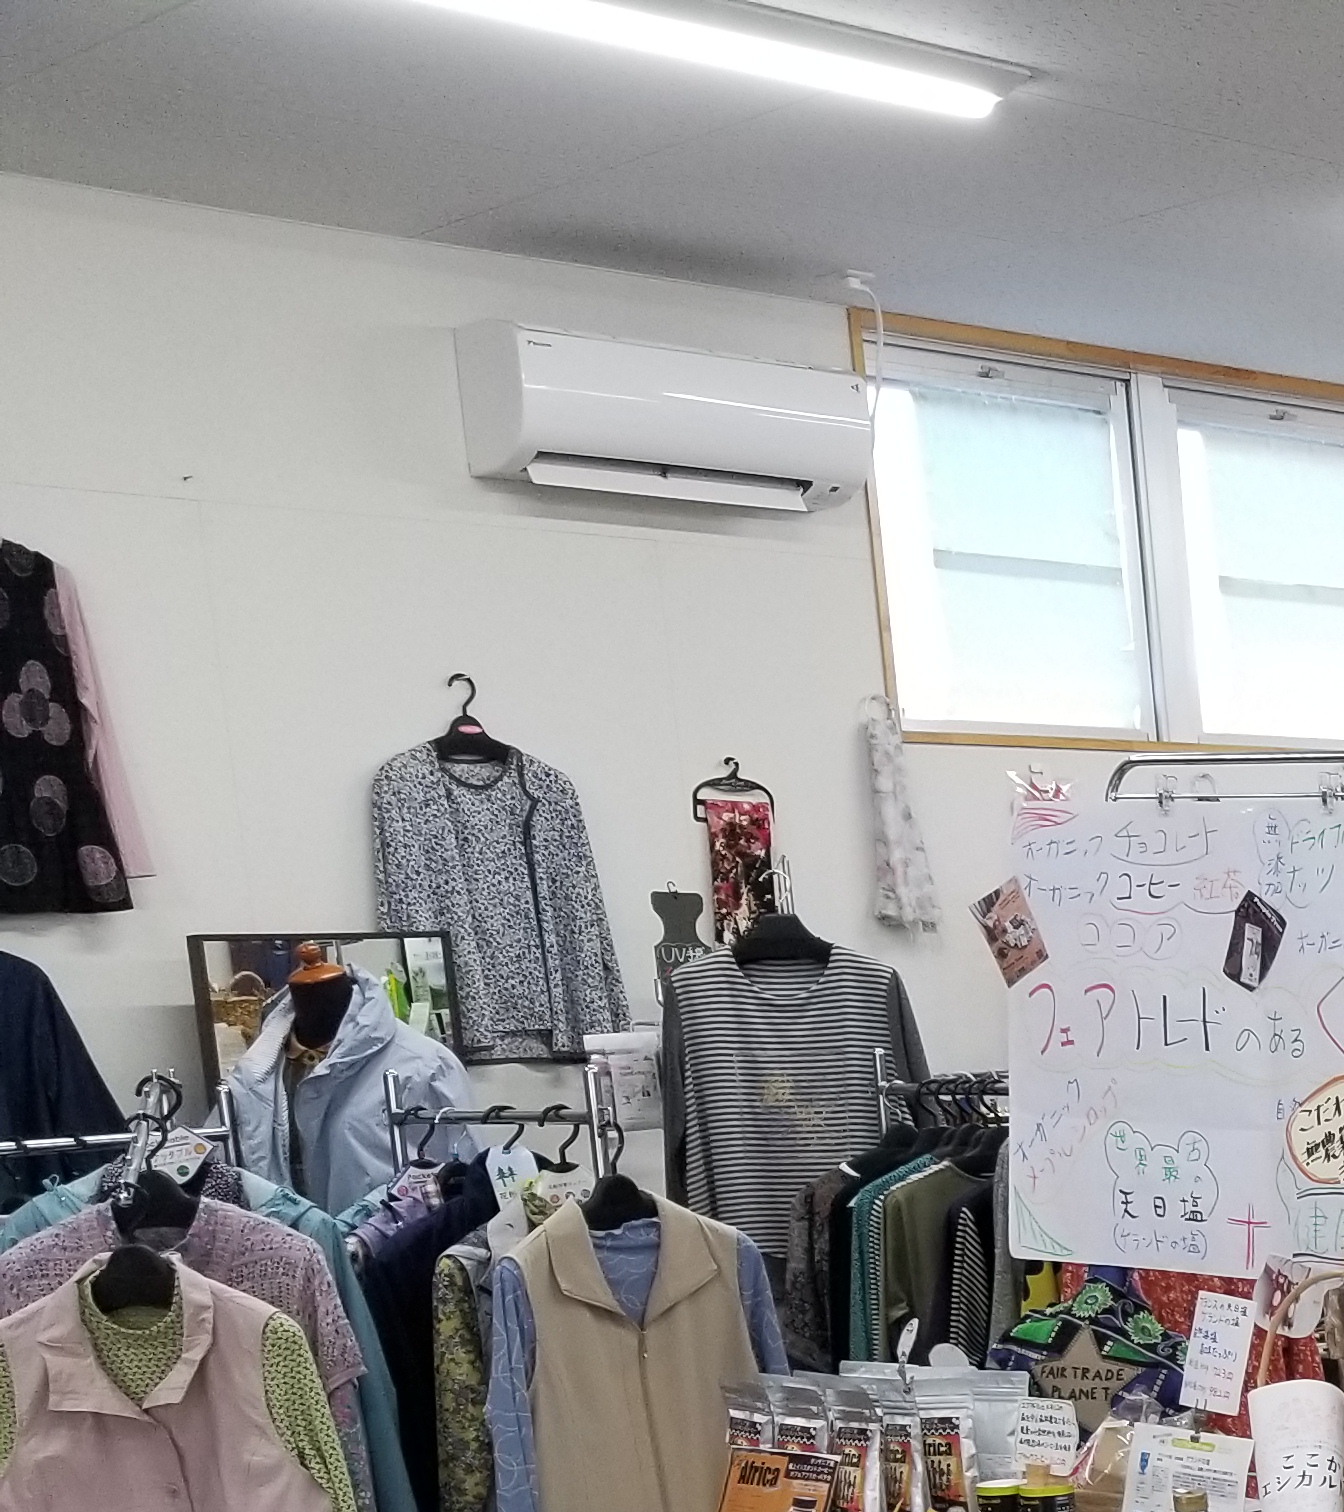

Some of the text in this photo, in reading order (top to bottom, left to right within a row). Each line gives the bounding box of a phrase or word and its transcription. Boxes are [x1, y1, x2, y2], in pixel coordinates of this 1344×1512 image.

[1023, 817, 1218, 861] オーガニック チョコレート
[1262, 814, 1285, 897] 無添加
[1024, 868, 1244, 906] オーガニック コーヒー 紅茶
[1287, 864, 1335, 894] ナッツ
[1080, 922, 1176, 954] ココア
[1119, 1189, 1208, 1223] 天日塩
[1040, 1366, 1125, 1382] FAIR TRADE
[1052, 1385, 1111, 1401] PLANET
[738, 1459, 781, 1488] Africa
